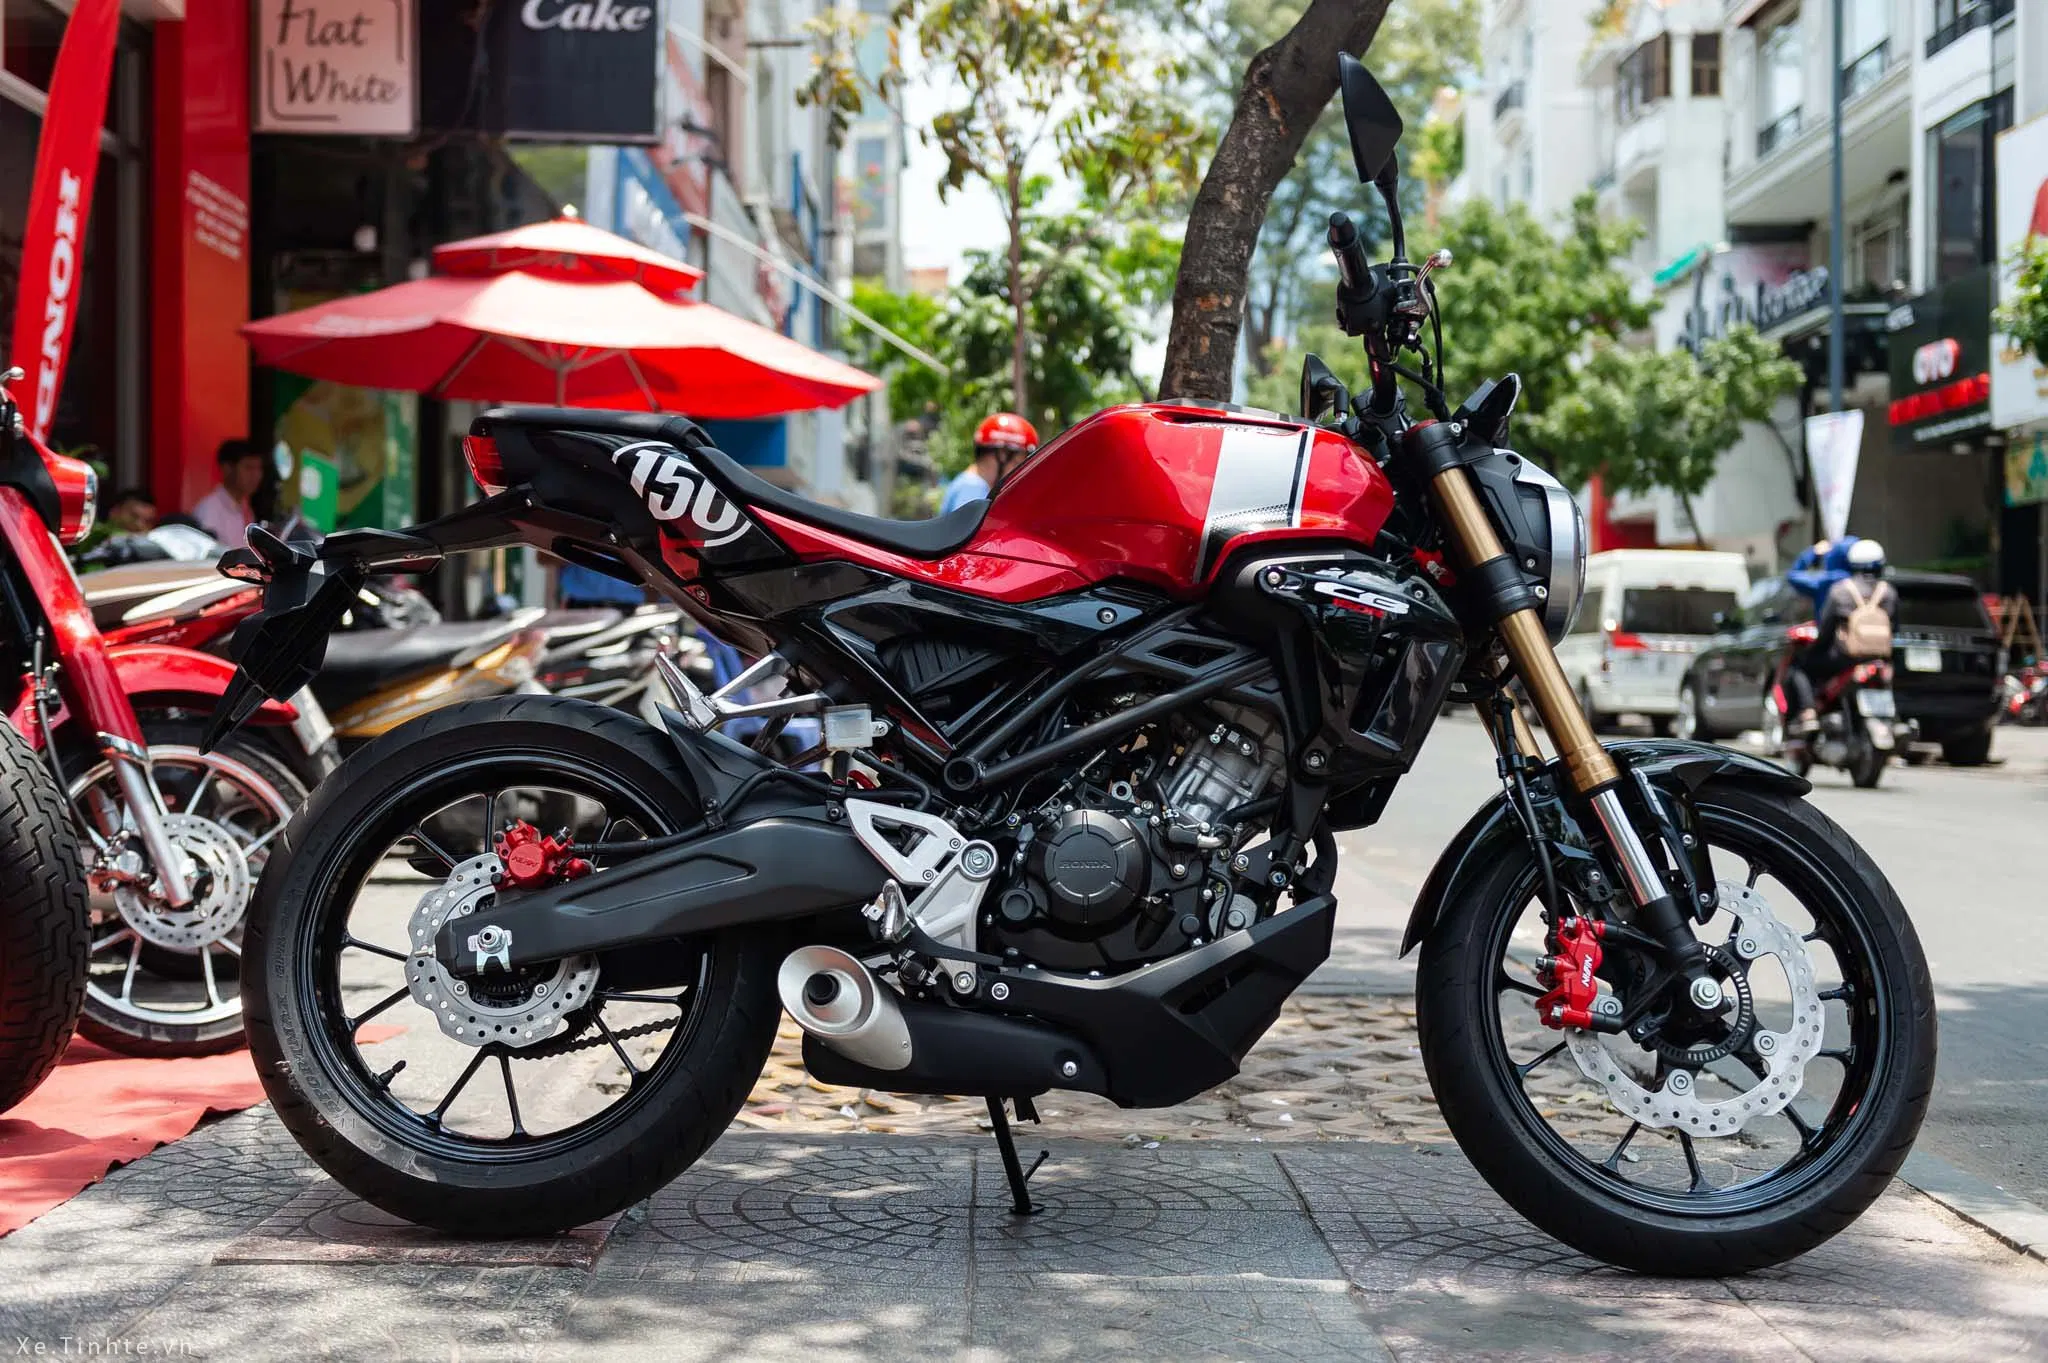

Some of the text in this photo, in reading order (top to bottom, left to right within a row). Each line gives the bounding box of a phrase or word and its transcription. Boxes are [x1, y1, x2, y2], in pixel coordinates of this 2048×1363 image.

[520, 0, 652, 31] Cake
[282, 57, 400, 104] White
[630, 448, 740, 532] 150
